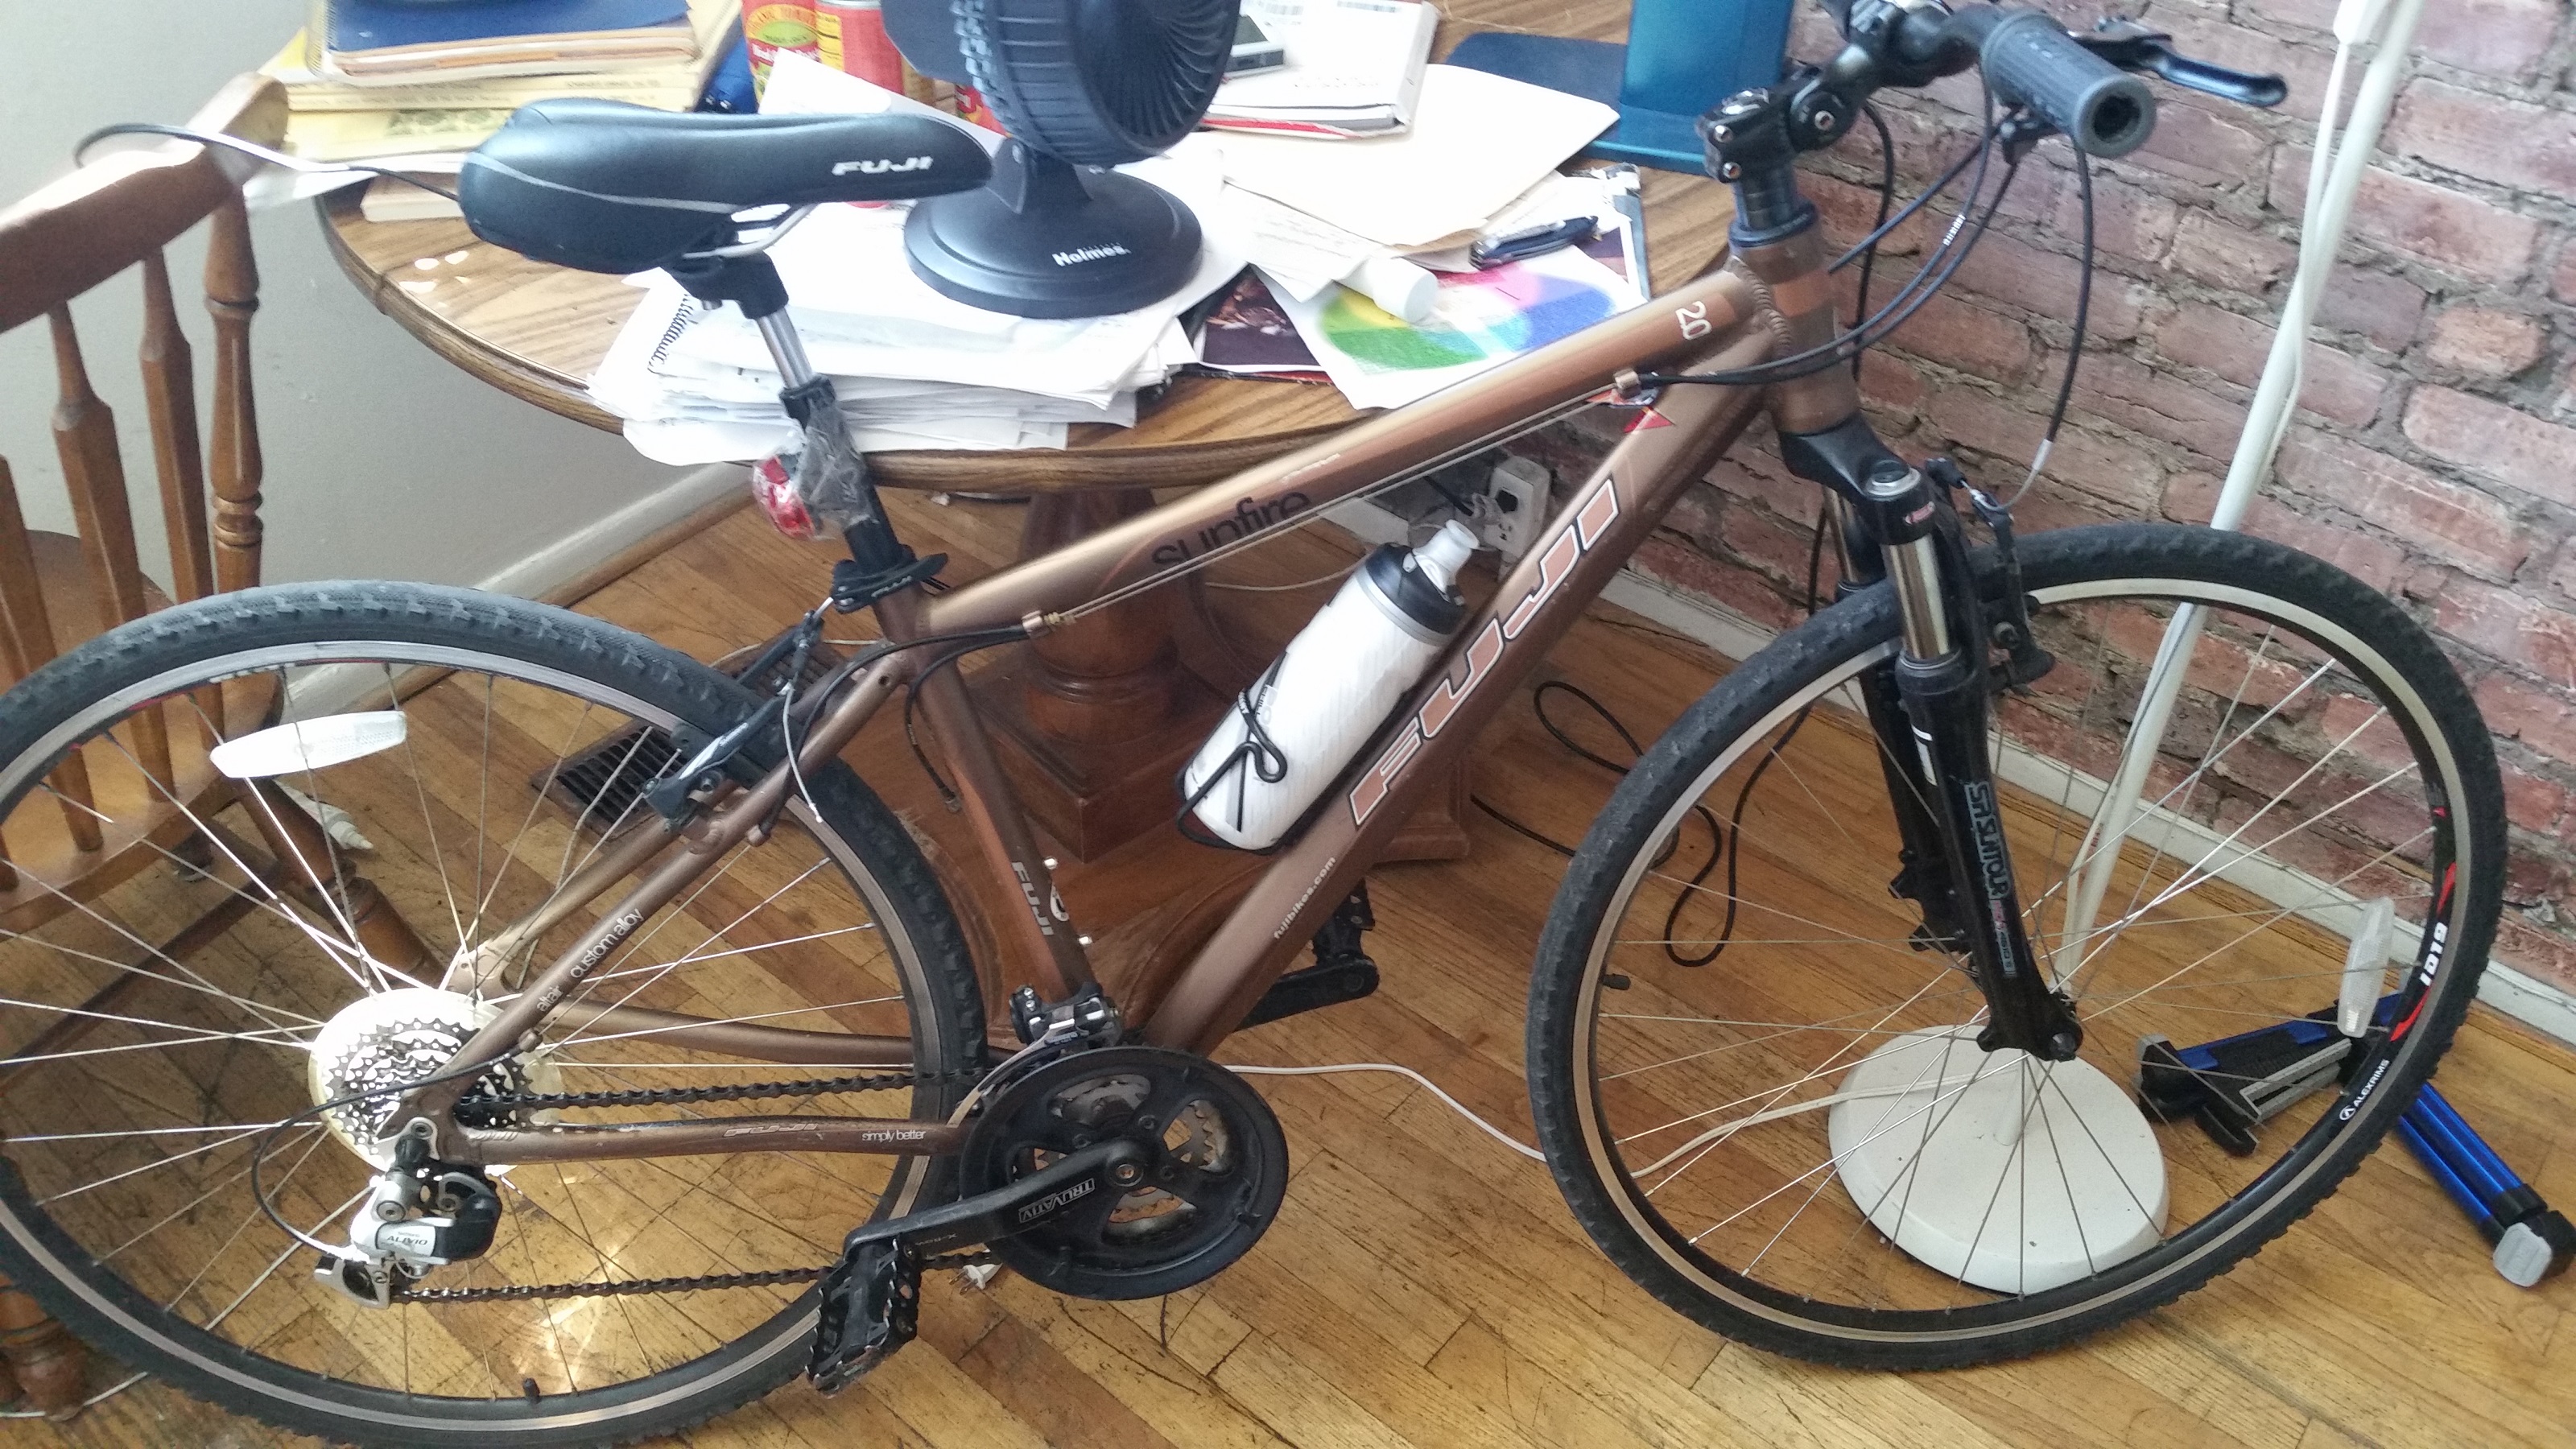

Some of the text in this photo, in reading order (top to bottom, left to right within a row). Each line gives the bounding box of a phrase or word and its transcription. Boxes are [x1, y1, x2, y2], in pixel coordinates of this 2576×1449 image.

[832, 155, 934, 176] FUJI
[1349, 477, 1620, 827] FUJI
[1011, 861, 1055, 936] FUJI
[1274, 857, 1336, 939] fujibikes.com
[570, 932, 620, 979] custom
[613, 908, 645, 936] alloy
[2353, 1059, 2390, 1108] ALEXRIMS
[724, 1123, 819, 1137] FUJI
[861, 1129, 927, 1143] simply better
[1020, 1178, 1095, 1222] TRUVATIV
